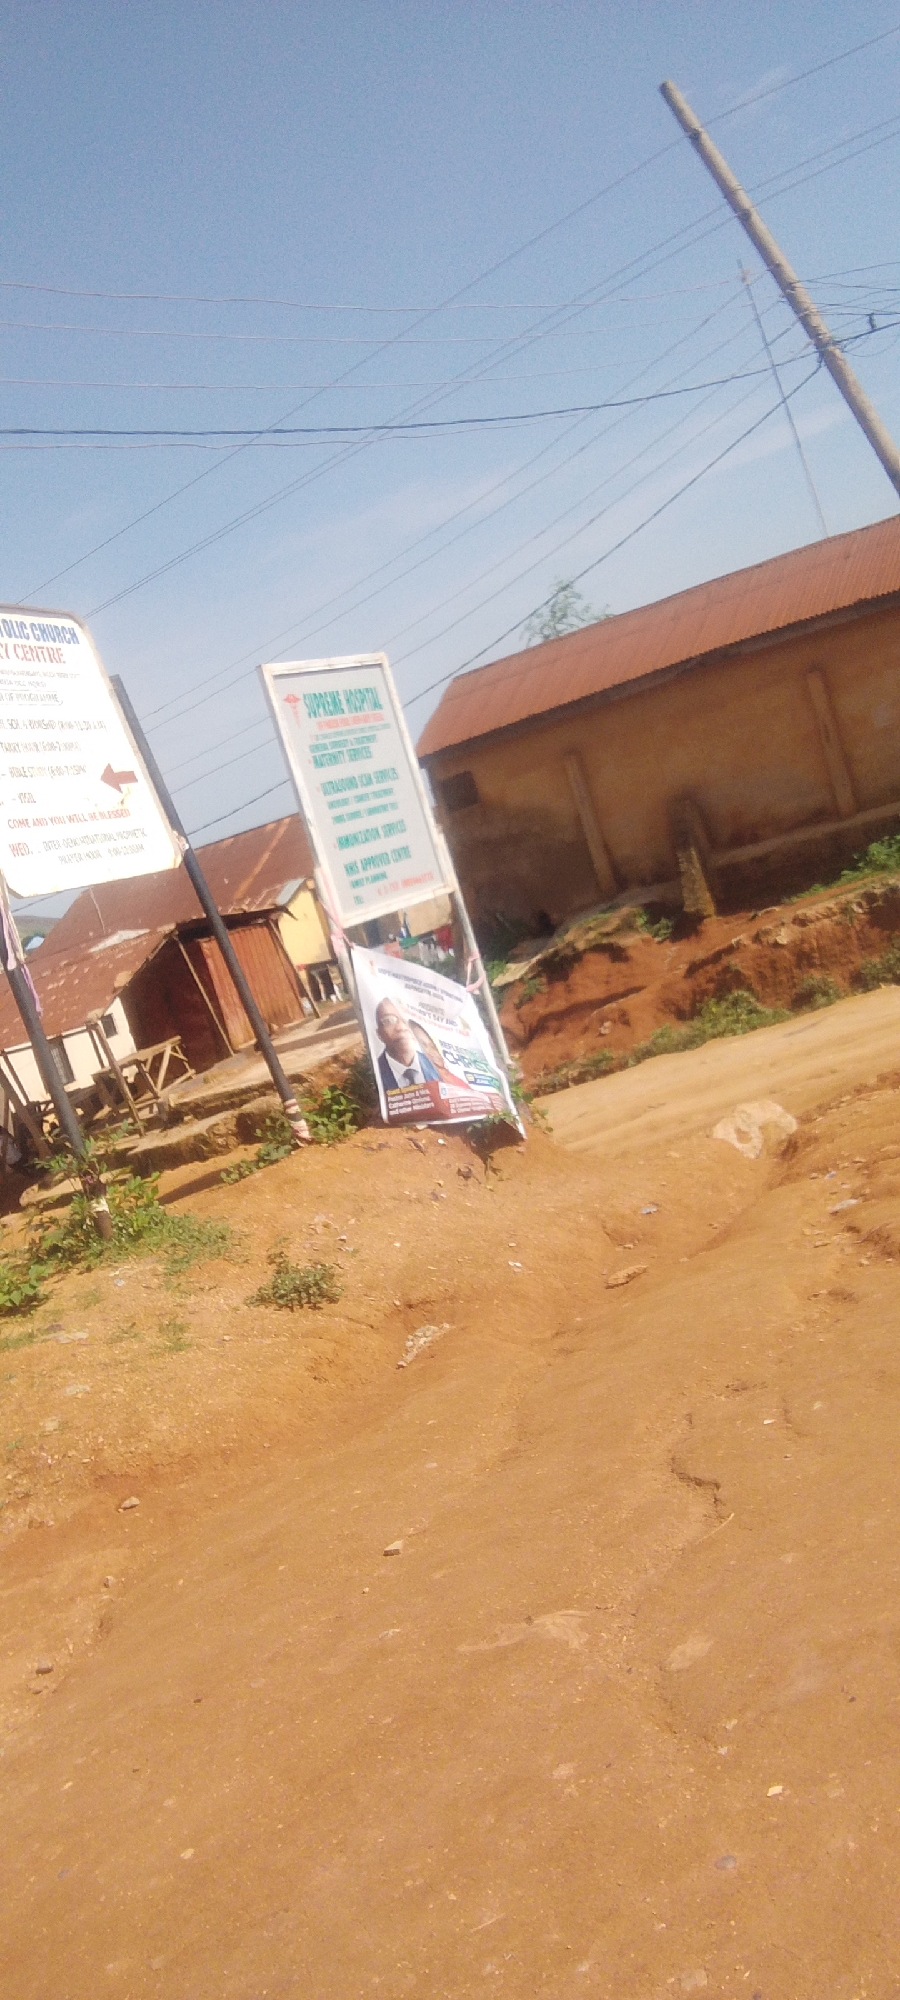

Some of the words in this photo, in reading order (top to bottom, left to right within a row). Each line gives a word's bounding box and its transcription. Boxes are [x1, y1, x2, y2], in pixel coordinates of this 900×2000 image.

[29, 622, 80, 645] CHURCH
[303, 690, 345, 719] SUPREME
[342, 687, 384, 714] HOSPITAL
[312, 750, 347, 769] MATERNITY
[345, 745, 373, 763] SERVICES
[321, 775, 359, 797] ULTRASOUND
[357, 772, 374, 788] SCAN
[373, 767, 399, 784] SERVICES
[7, 818, 31, 829] COME
[32, 817, 49, 827] AND
[48, 815, 67, 826] YOU
[66, 813, 89, 824] WILL
[88, 811, 99, 822] BE
[99, 808, 132, 821] BLESSED
[380, 819, 407, 838] SERVICES
[58, 853, 84, 865] PRAYER
[360, 852, 391, 871] APPROVED
[390, 845, 412, 863] CENTRE
